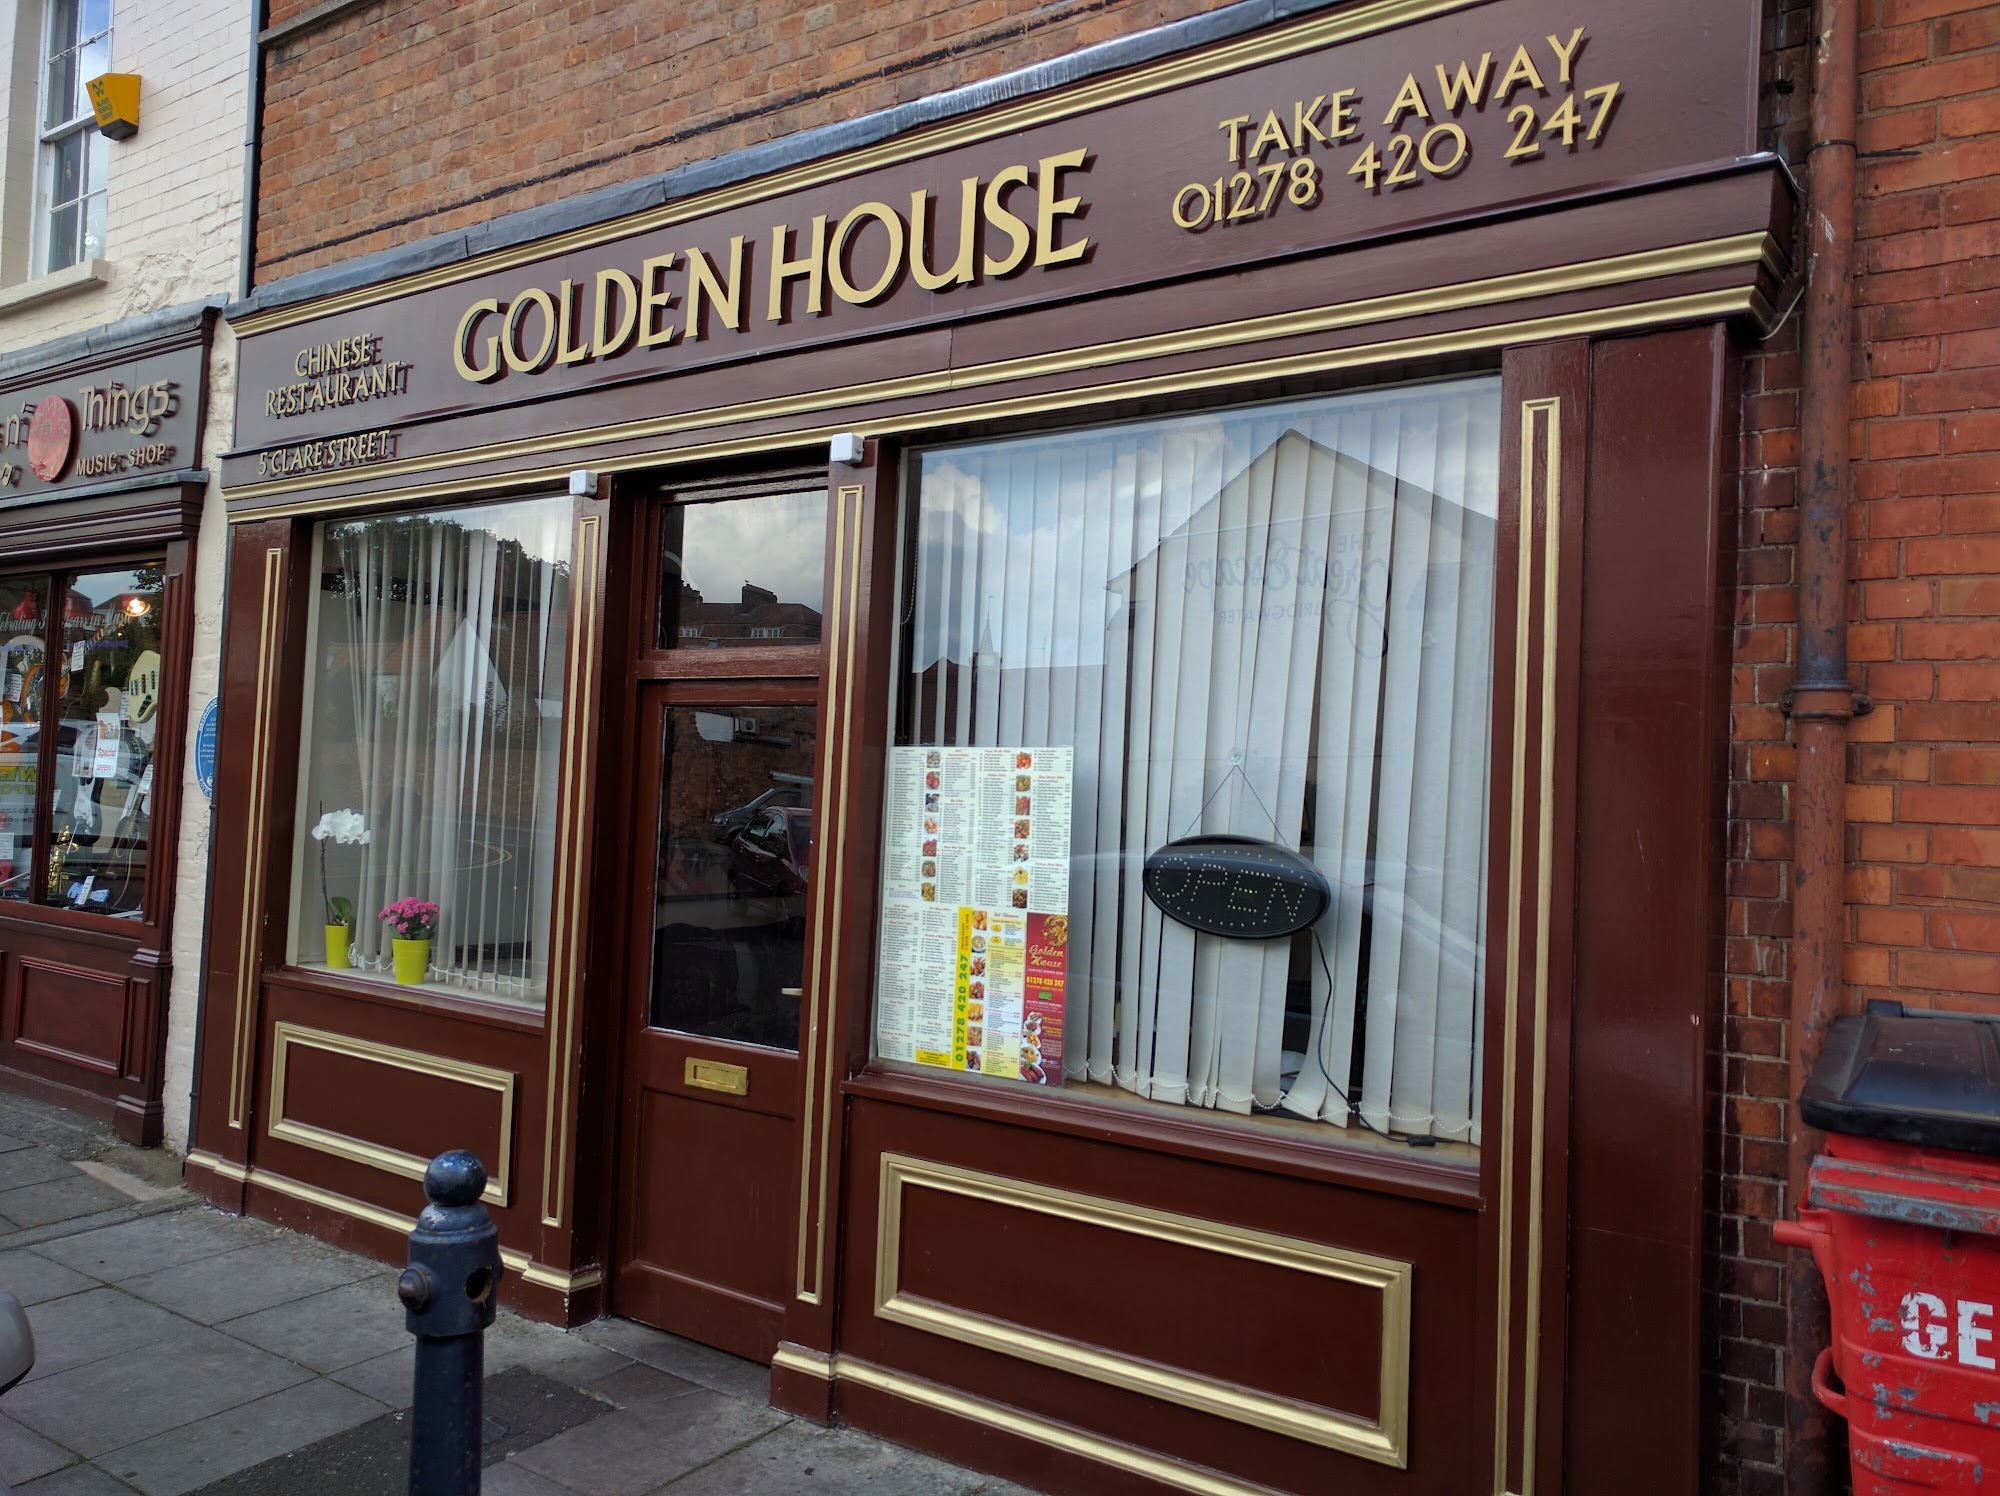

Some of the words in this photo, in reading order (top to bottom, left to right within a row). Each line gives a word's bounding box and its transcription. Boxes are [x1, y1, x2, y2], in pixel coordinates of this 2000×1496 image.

[1219, 87, 1357, 163] TAKE
[1172, 157, 1316, 229] 01278
[1347, 123, 1467, 190] 420
[1503, 82, 1621, 160] 247
[453, 235, 746, 383] GOLDEN
[767, 147, 1091, 321] HOUSE
[295, 333, 372, 377] CHINESE
[79, 378, 171, 436] Things
[265, 360, 402, 417] RESTAURANT
[76, 450, 117, 477] MUSIC
[127, 443, 167, 467] SHOP
[258, 454, 268, 476] 5
[271, 440, 322, 474] CLARE
[323, 429, 392, 466] STREET
[97, 748, 116, 759] Special
[1156, 857, 1308, 922] OPEN
[960, 953, 969, 980] 247
[1028, 945, 1064, 957] Golden
[1030, 954, 1063, 968] House
[957, 986, 967, 1010] 420
[1054, 979, 1064, 987] 247
[955, 1018, 965, 1062] 01278
[1901, 1291, 1996, 1370] GE
